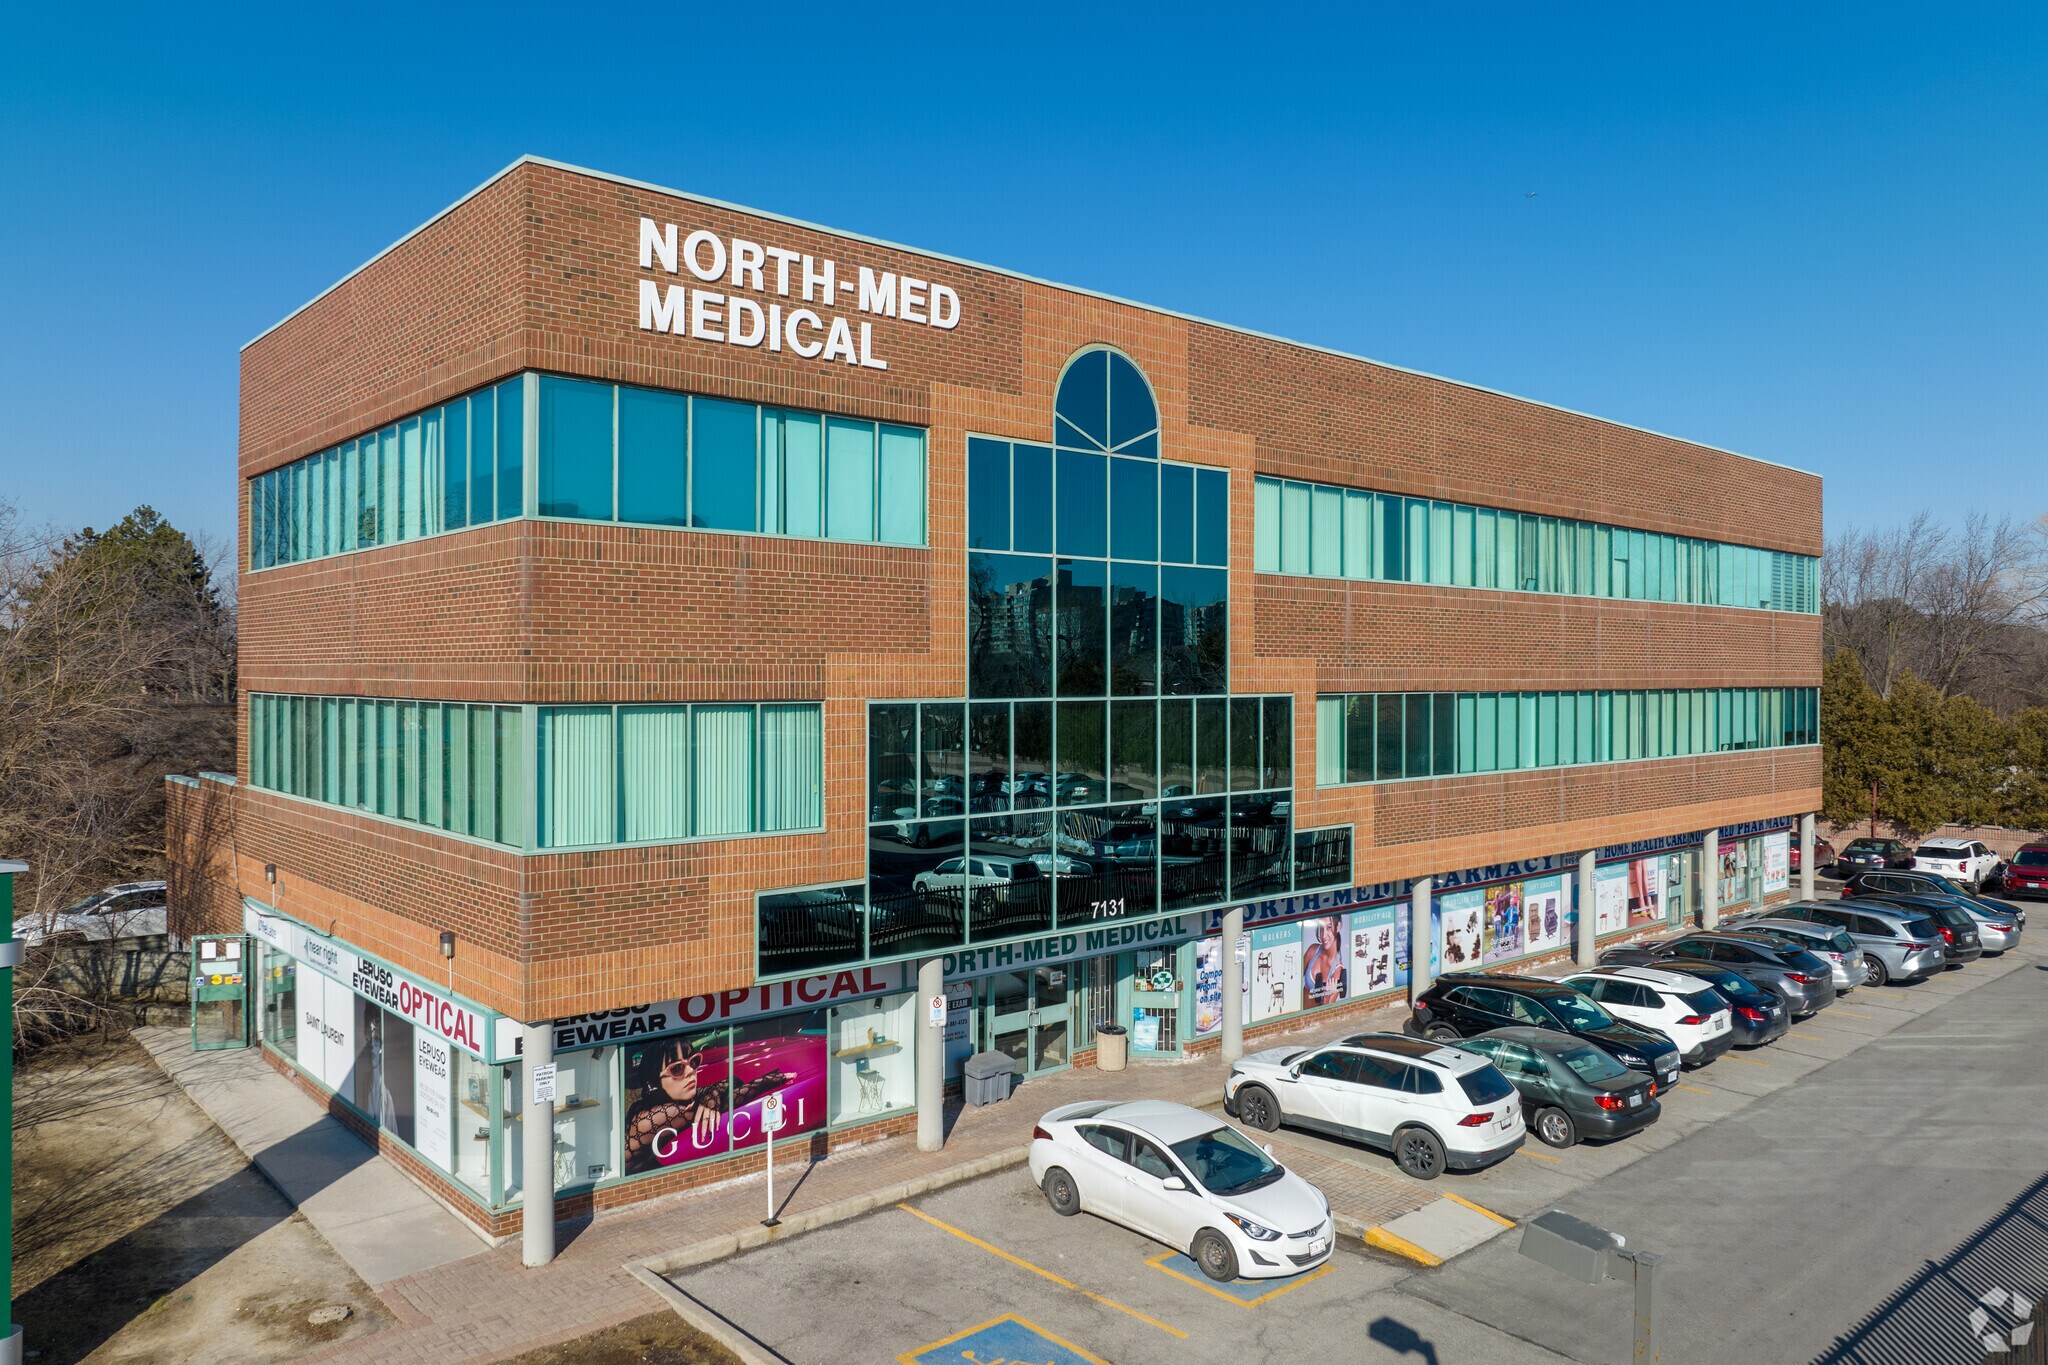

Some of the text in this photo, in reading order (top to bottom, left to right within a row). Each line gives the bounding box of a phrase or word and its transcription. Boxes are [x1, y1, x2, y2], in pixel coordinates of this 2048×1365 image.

[639, 217, 961, 330] NORTH-MED
[639, 279, 887, 371] MEDICAL
[1604, 844, 1630, 858] HOME
[1631, 840, 1665, 853] HEALTH
[1666, 834, 1687, 847] CARE
[1091, 898, 1125, 919] 7131
[1354, 911, 1392, 925] MOBILITY AID
[943, 916, 1187, 977] ORTH-MED MEDICAL
[1262, 929, 1292, 942] WALKERS
[323, 945, 338, 965] right
[358, 957, 393, 988] LERUSO
[353, 972, 399, 1011] EYEWEAR
[678, 967, 886, 1024] OPTICAL
[1200, 982, 1217, 992] room
[1200, 991, 1222, 1004] on site
[952, 999, 968, 1009] EXAM
[306, 1012, 320, 1035] SAINT
[400, 981, 480, 1053] OPTICAL
[321, 1022, 345, 1047] LAURENT
[419, 1038, 446, 1065] LERUSO
[419, 1054, 446, 1079] EYEWEAR
